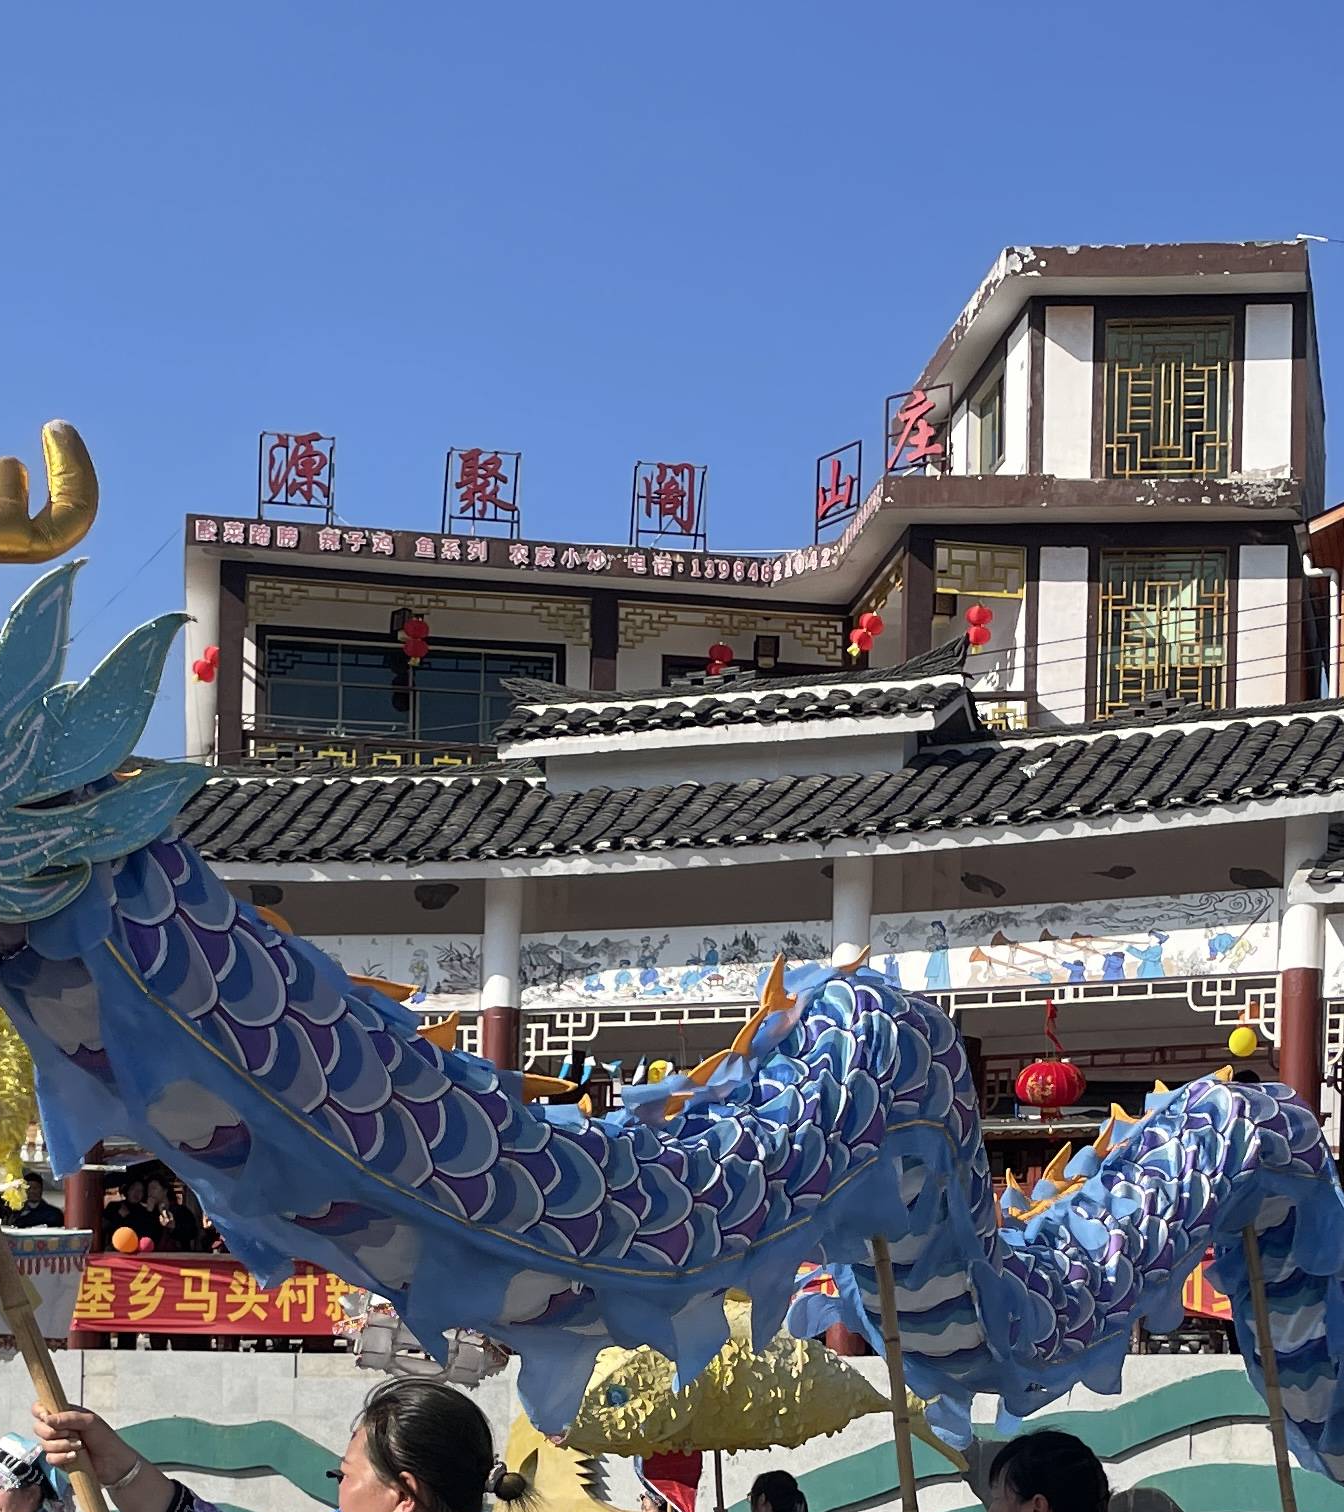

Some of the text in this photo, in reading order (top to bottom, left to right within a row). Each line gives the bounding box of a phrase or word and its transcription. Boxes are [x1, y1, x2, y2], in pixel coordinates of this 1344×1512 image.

[414, 536, 488, 563] 鱼系列
[508, 543, 608, 571] 农家小炒
